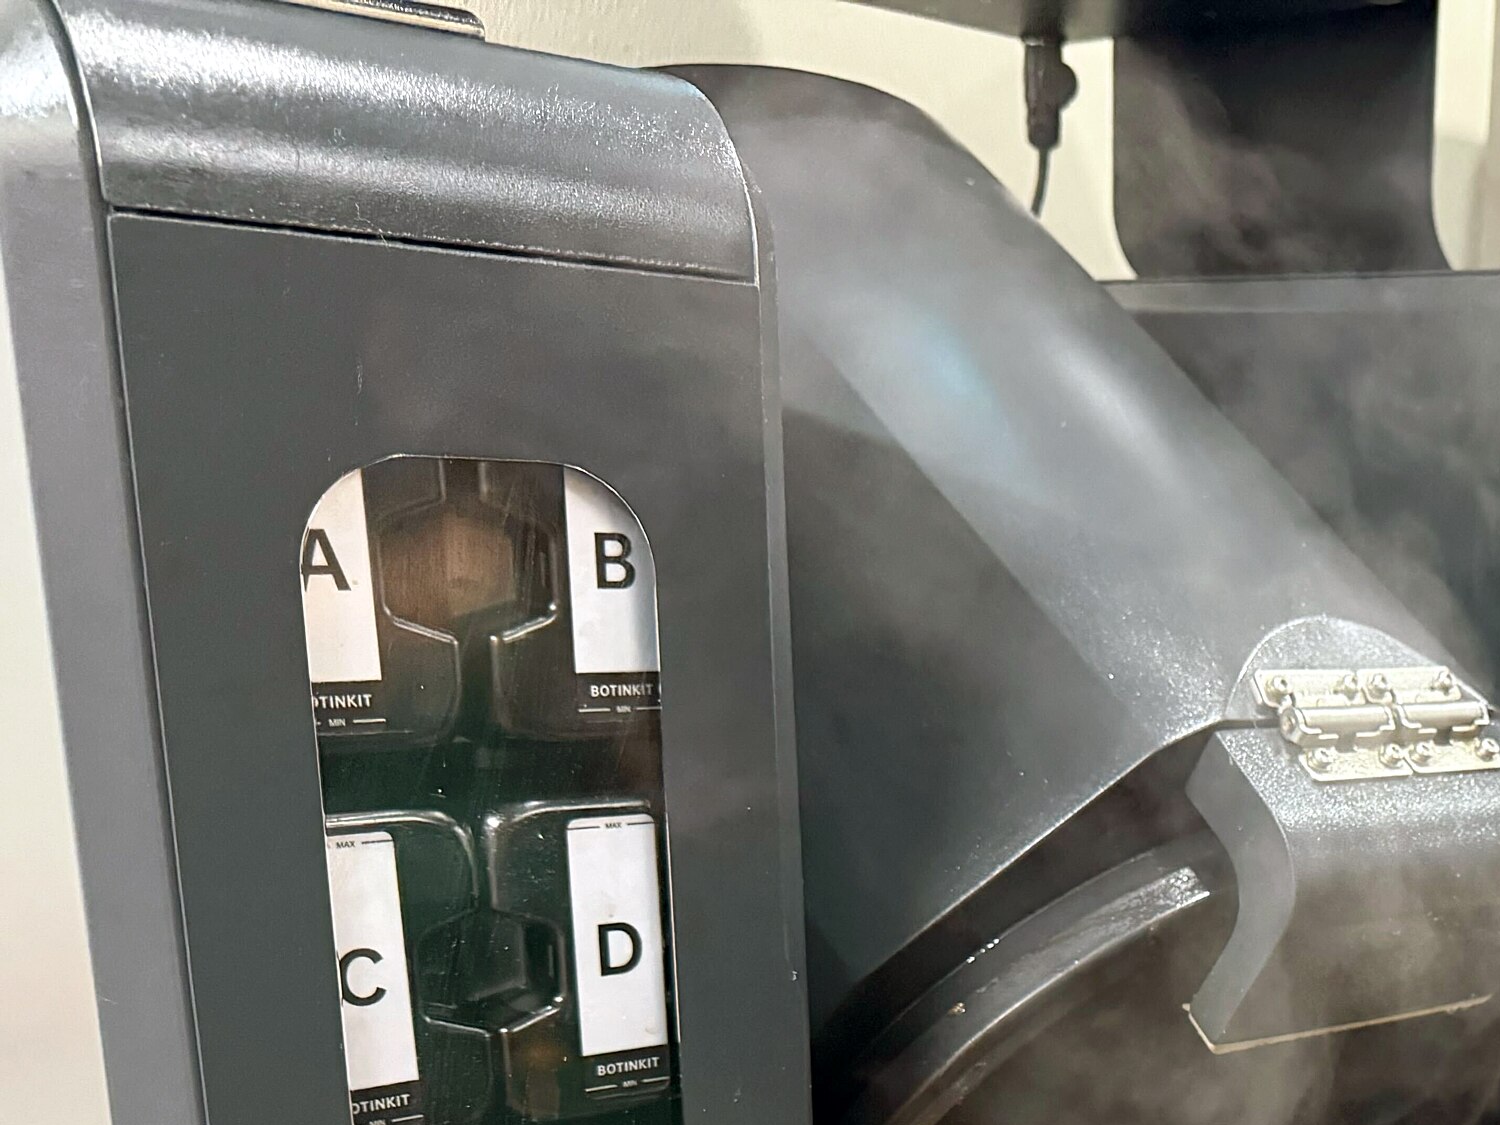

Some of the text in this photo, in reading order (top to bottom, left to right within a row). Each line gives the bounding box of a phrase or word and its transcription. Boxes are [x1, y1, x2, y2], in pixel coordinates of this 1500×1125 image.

[301, 528, 352, 591] A
[594, 532, 636, 589] B
[590, 682, 653, 698] BOTINKIT
[598, 922, 642, 976] D
[340, 948, 387, 1006] C
[597, 1056, 659, 1076] BOTINKIT
